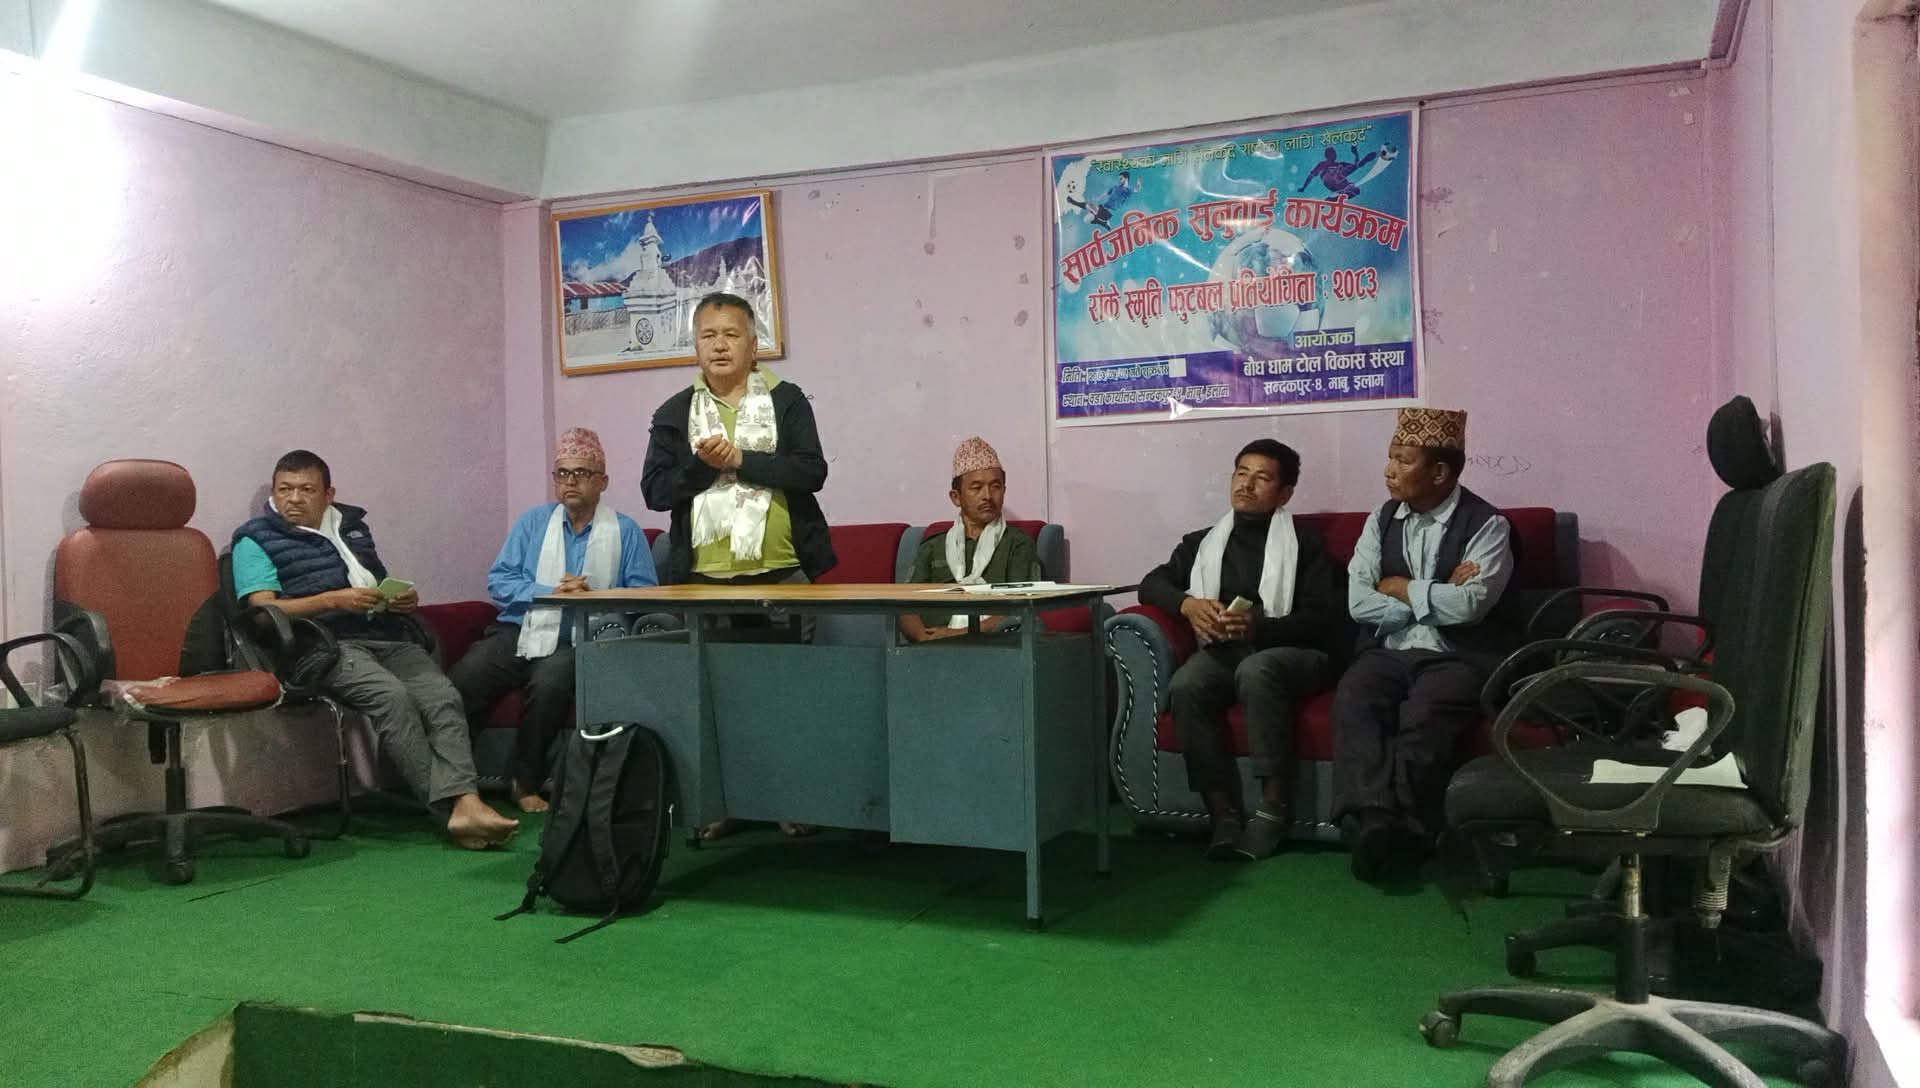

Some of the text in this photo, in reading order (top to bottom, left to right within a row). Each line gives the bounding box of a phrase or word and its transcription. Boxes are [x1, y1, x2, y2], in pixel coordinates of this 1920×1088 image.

[1284, 132, 1315, 152] लागि
[1059, 189, 1409, 285] सार्वजनिक सुनुवाई कार्यक्रम
[1124, 276, 1164, 328] स्मृति
[1166, 281, 1224, 323] फुटबल
[1229, 265, 1317, 313] प्रतियोगिता
[1332, 266, 1379, 301] २०८३
[1294, 331, 1354, 348] आयोजक
[1295, 352, 1321, 373] टोल
[1324, 350, 1366, 371] विकास
[1369, 348, 1406, 368] संस्था
[1353, 374, 1385, 389] इलाम
